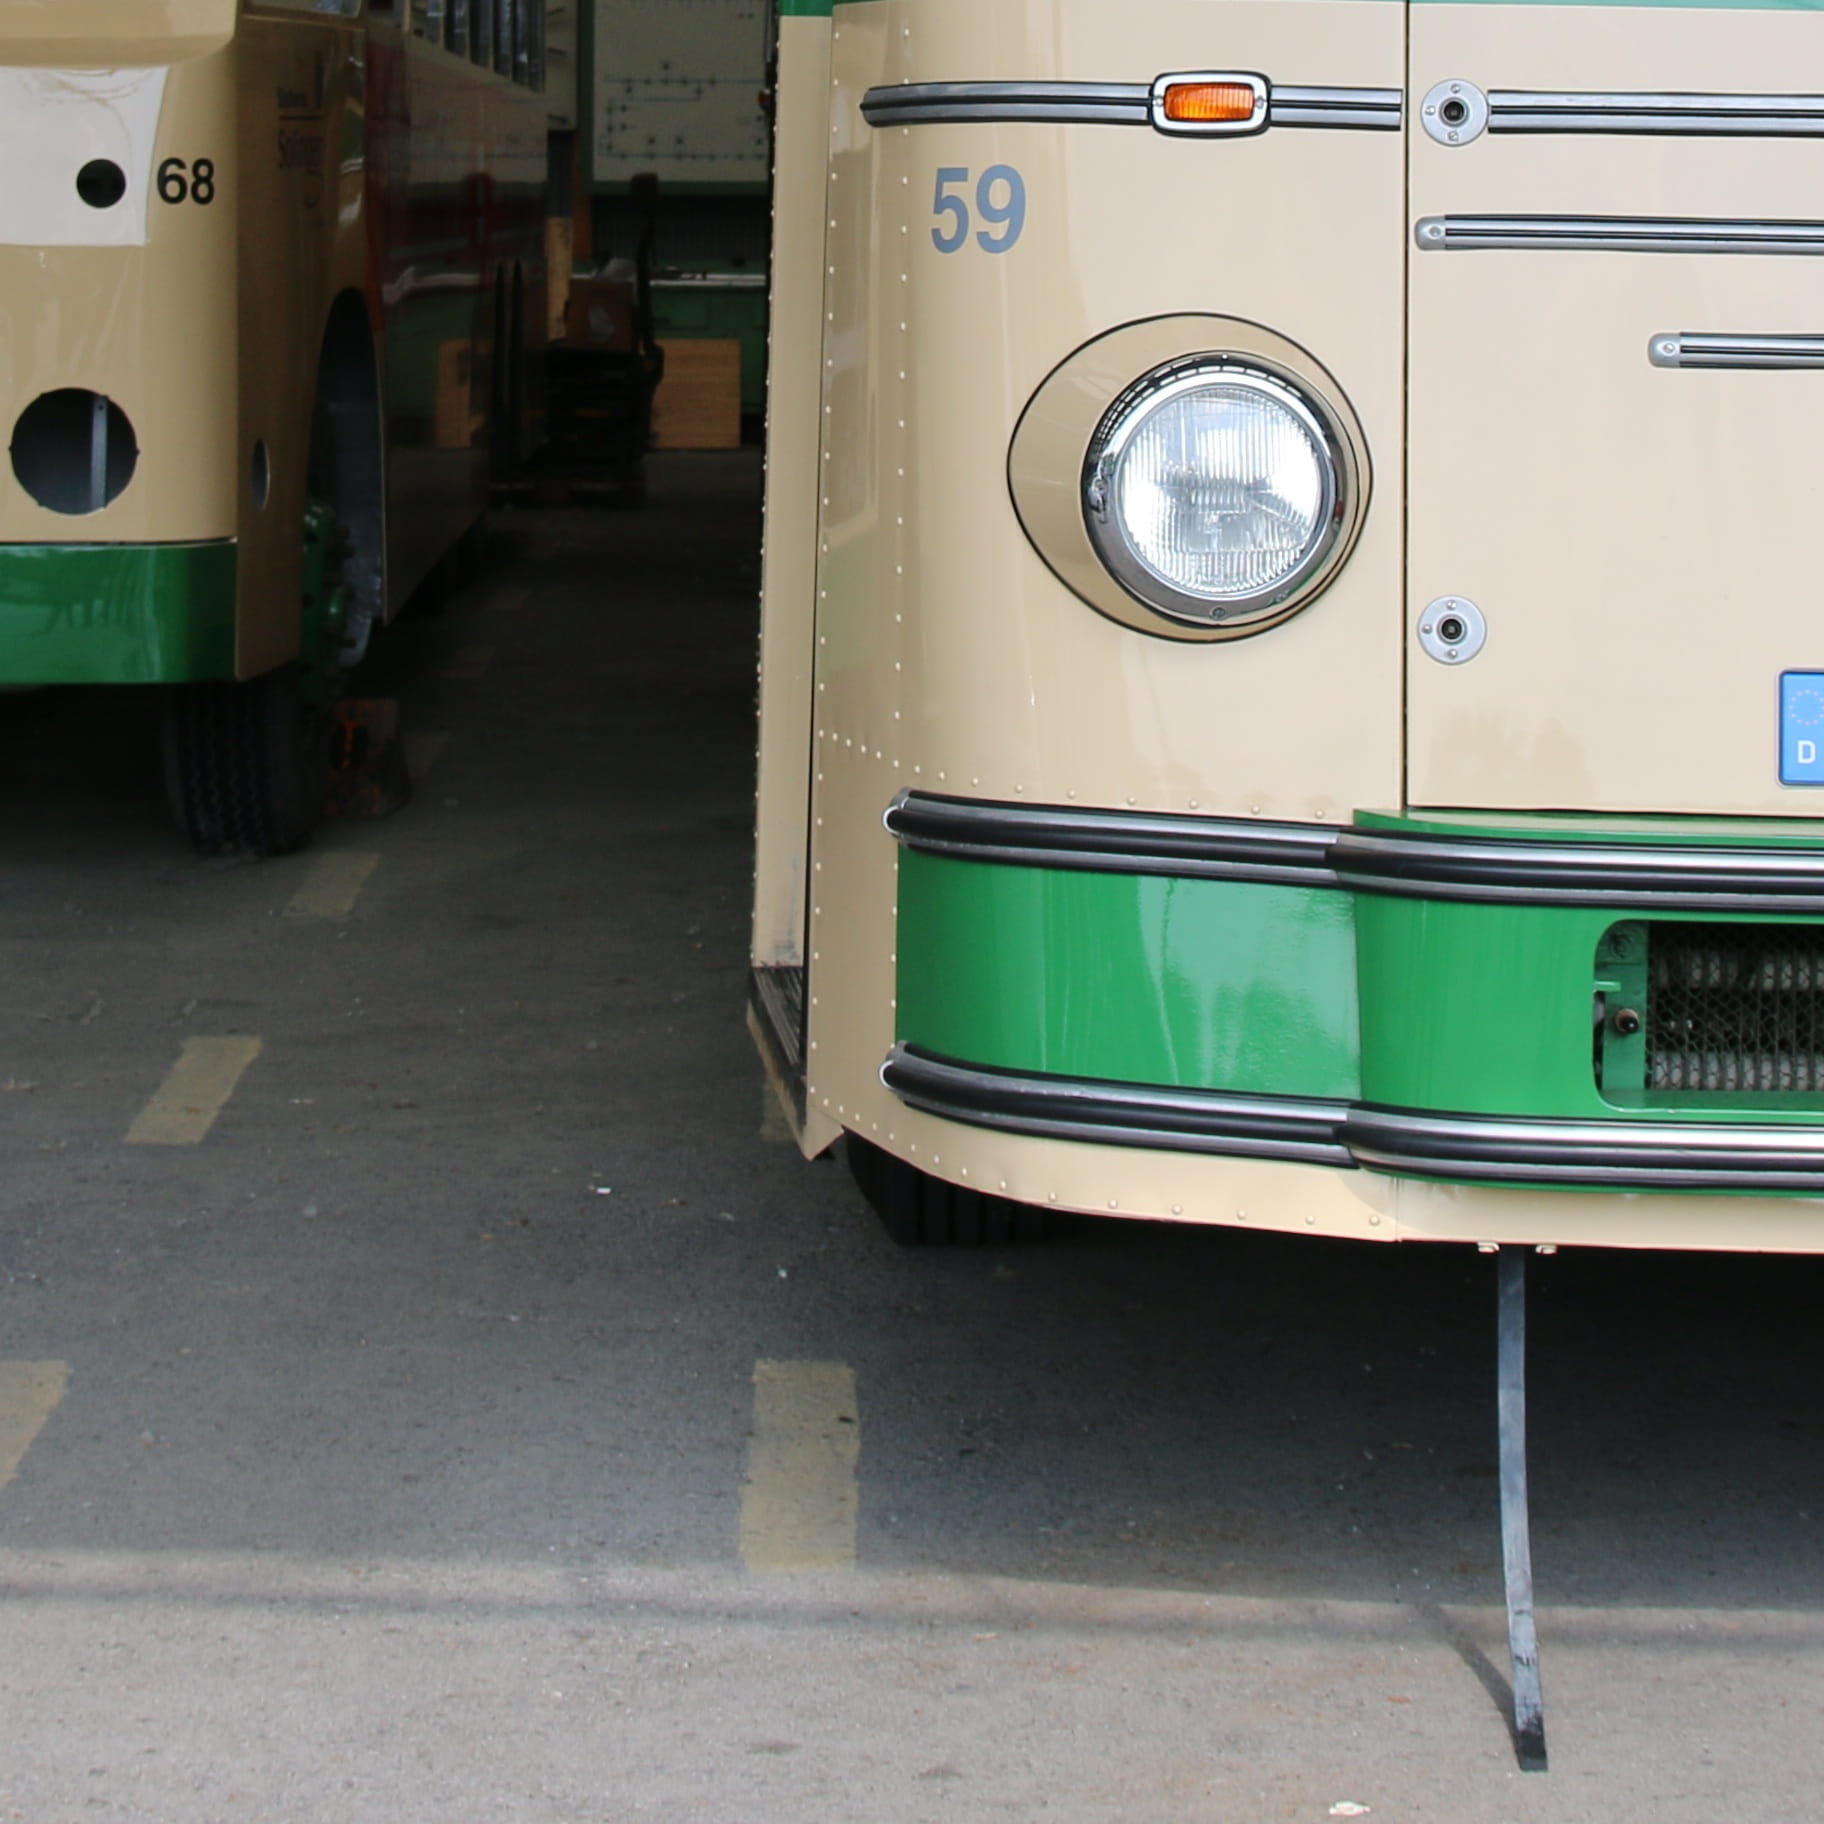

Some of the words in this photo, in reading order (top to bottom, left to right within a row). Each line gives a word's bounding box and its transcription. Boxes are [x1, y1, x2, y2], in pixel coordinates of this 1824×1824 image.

[157, 157, 215, 206] 68
[930, 164, 1027, 254] 59
[1796, 740, 1817, 764] D
